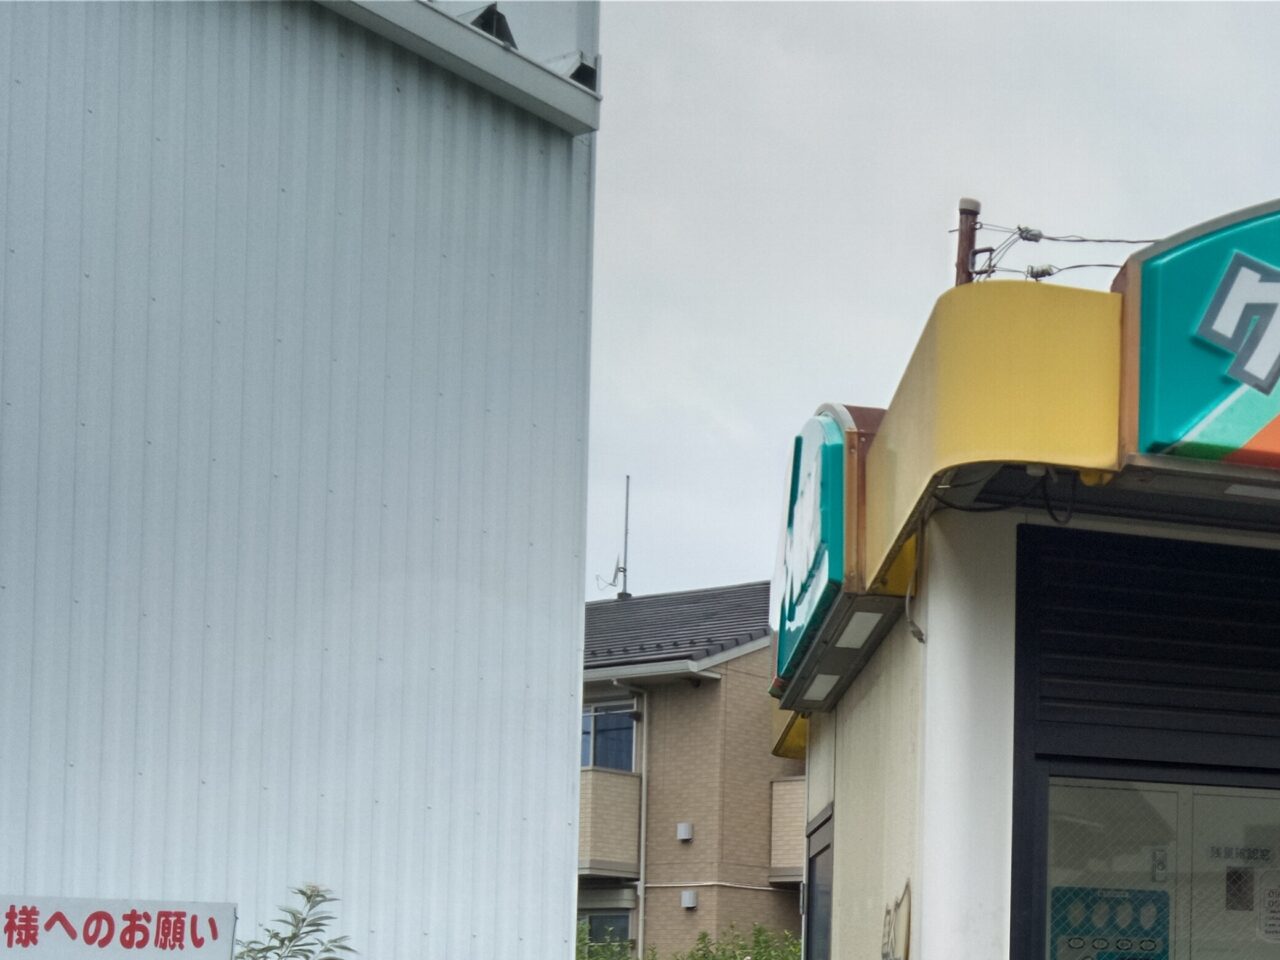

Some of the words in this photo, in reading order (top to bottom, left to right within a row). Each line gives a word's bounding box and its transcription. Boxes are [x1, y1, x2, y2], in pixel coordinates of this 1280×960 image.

[4, 904, 219, 950] 様へのお願い
